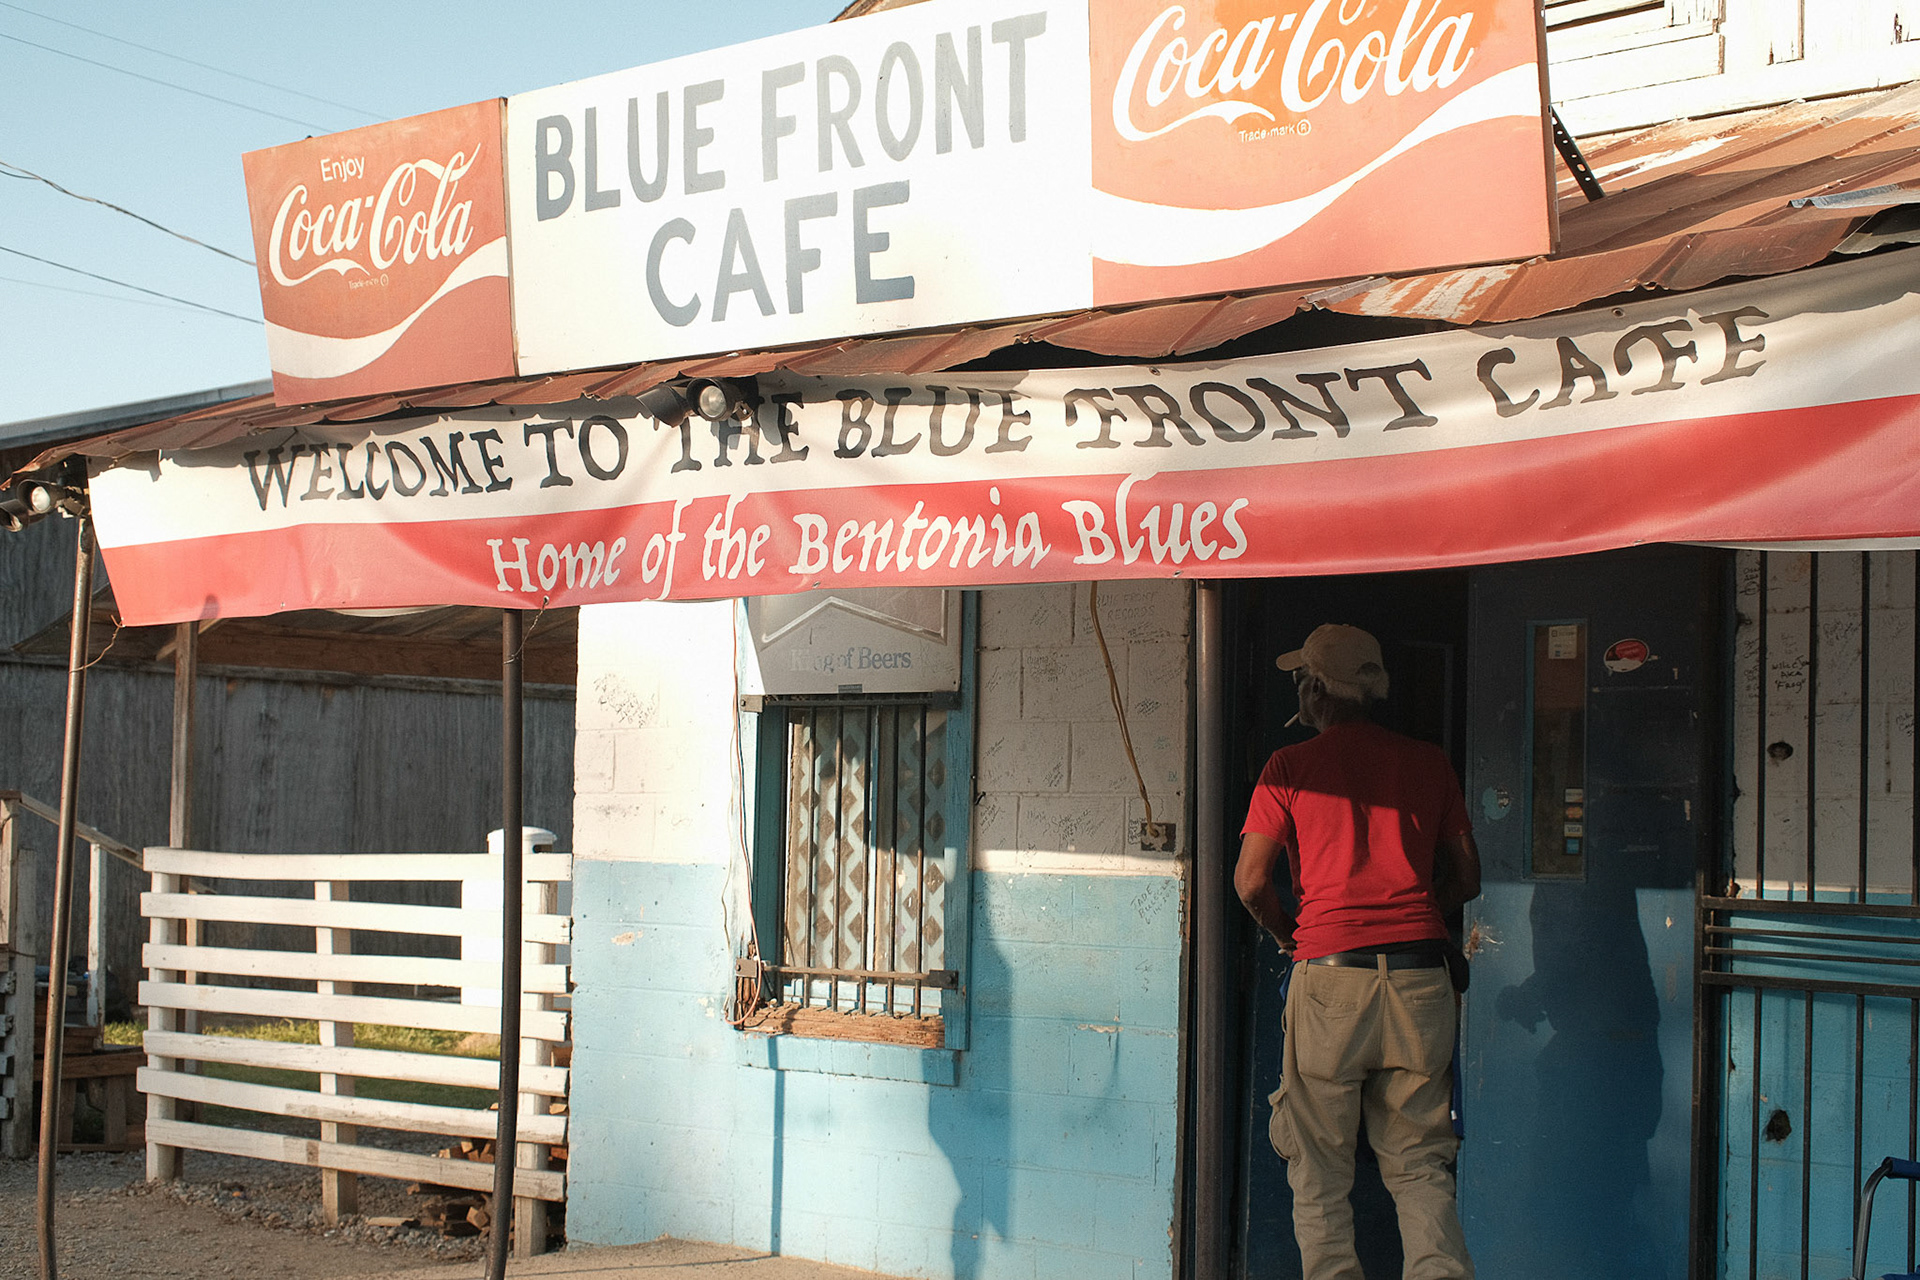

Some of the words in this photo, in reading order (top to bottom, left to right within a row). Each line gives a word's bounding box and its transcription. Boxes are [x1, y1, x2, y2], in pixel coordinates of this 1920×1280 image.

[536, 79, 726, 221] BLUE
[761, 11, 1048, 183] FRONT
[1113, 0, 1475, 141] Coca-Cola
[268, 142, 482, 287] Coca-Cola
[320, 155, 366, 184] Enjoy
[646, 179, 915, 327] CAFE
[243, 429, 513, 511] WELCOME
[523, 415, 628, 488] TO
[833, 385, 1033, 460] BLUE
[1064, 358, 1438, 449] FRONT
[1477, 306, 1770, 417] CAFE
[487, 533, 628, 593] Home
[641, 496, 693, 601] of
[701, 490, 771, 581] the
[787, 486, 1053, 577] Bentonia
[1061, 471, 1251, 566] Blues
[857, 646, 912, 669] Beers
